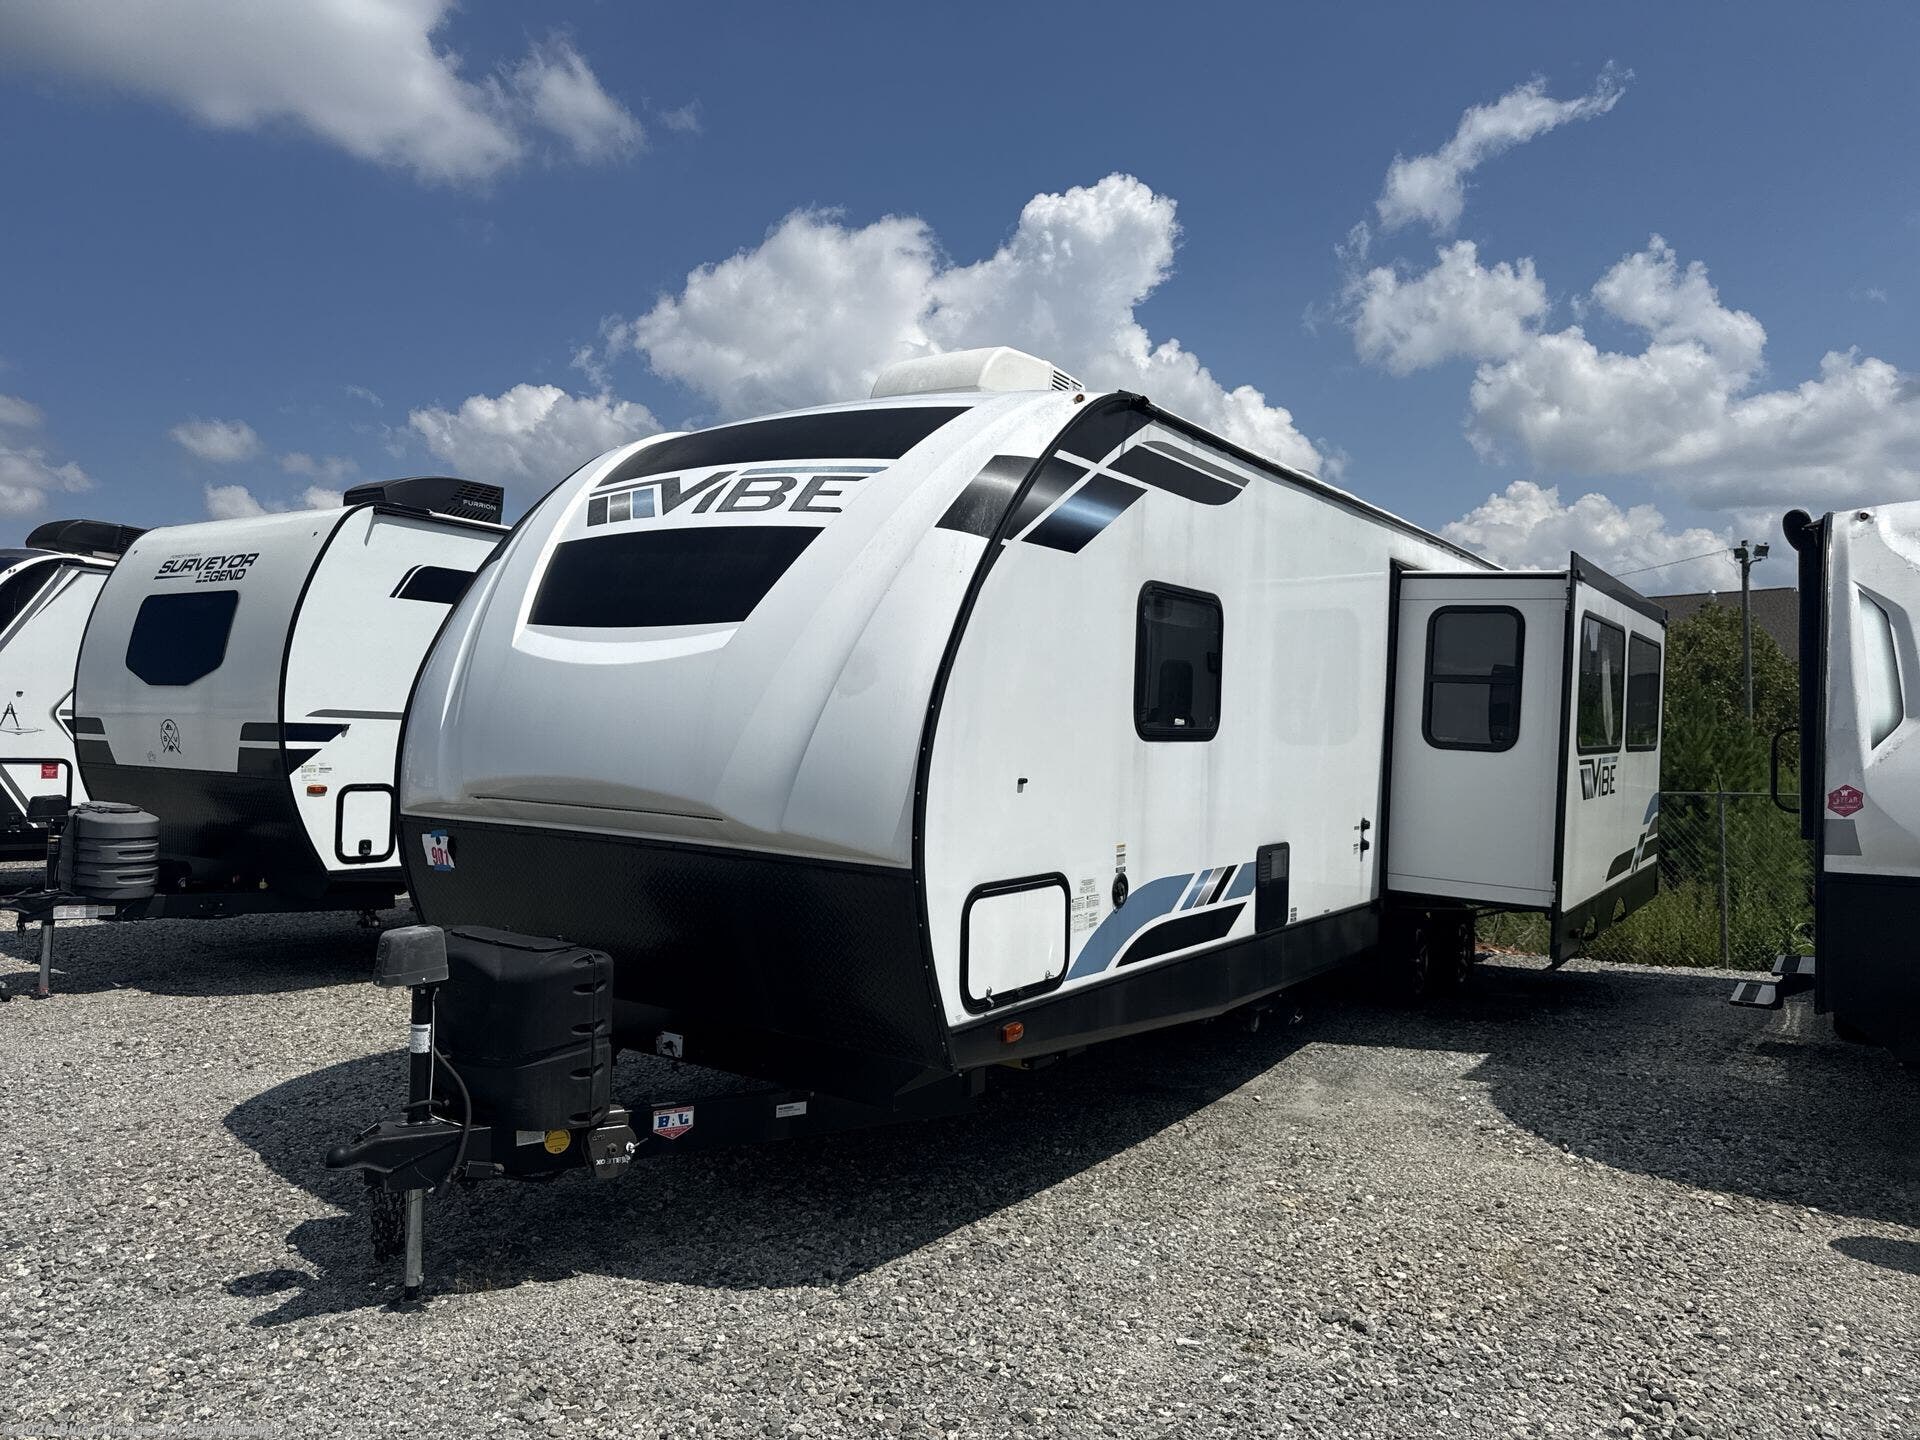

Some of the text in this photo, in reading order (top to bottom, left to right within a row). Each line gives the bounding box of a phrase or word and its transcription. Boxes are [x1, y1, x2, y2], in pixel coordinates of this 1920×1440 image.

[463, 499, 496, 510] FURRION
[589, 470, 870, 516] VIBE
[158, 552, 260, 575] SURVEYOR
[195, 568, 246, 583] LEGEND
[1579, 757, 1617, 798] VIBE
